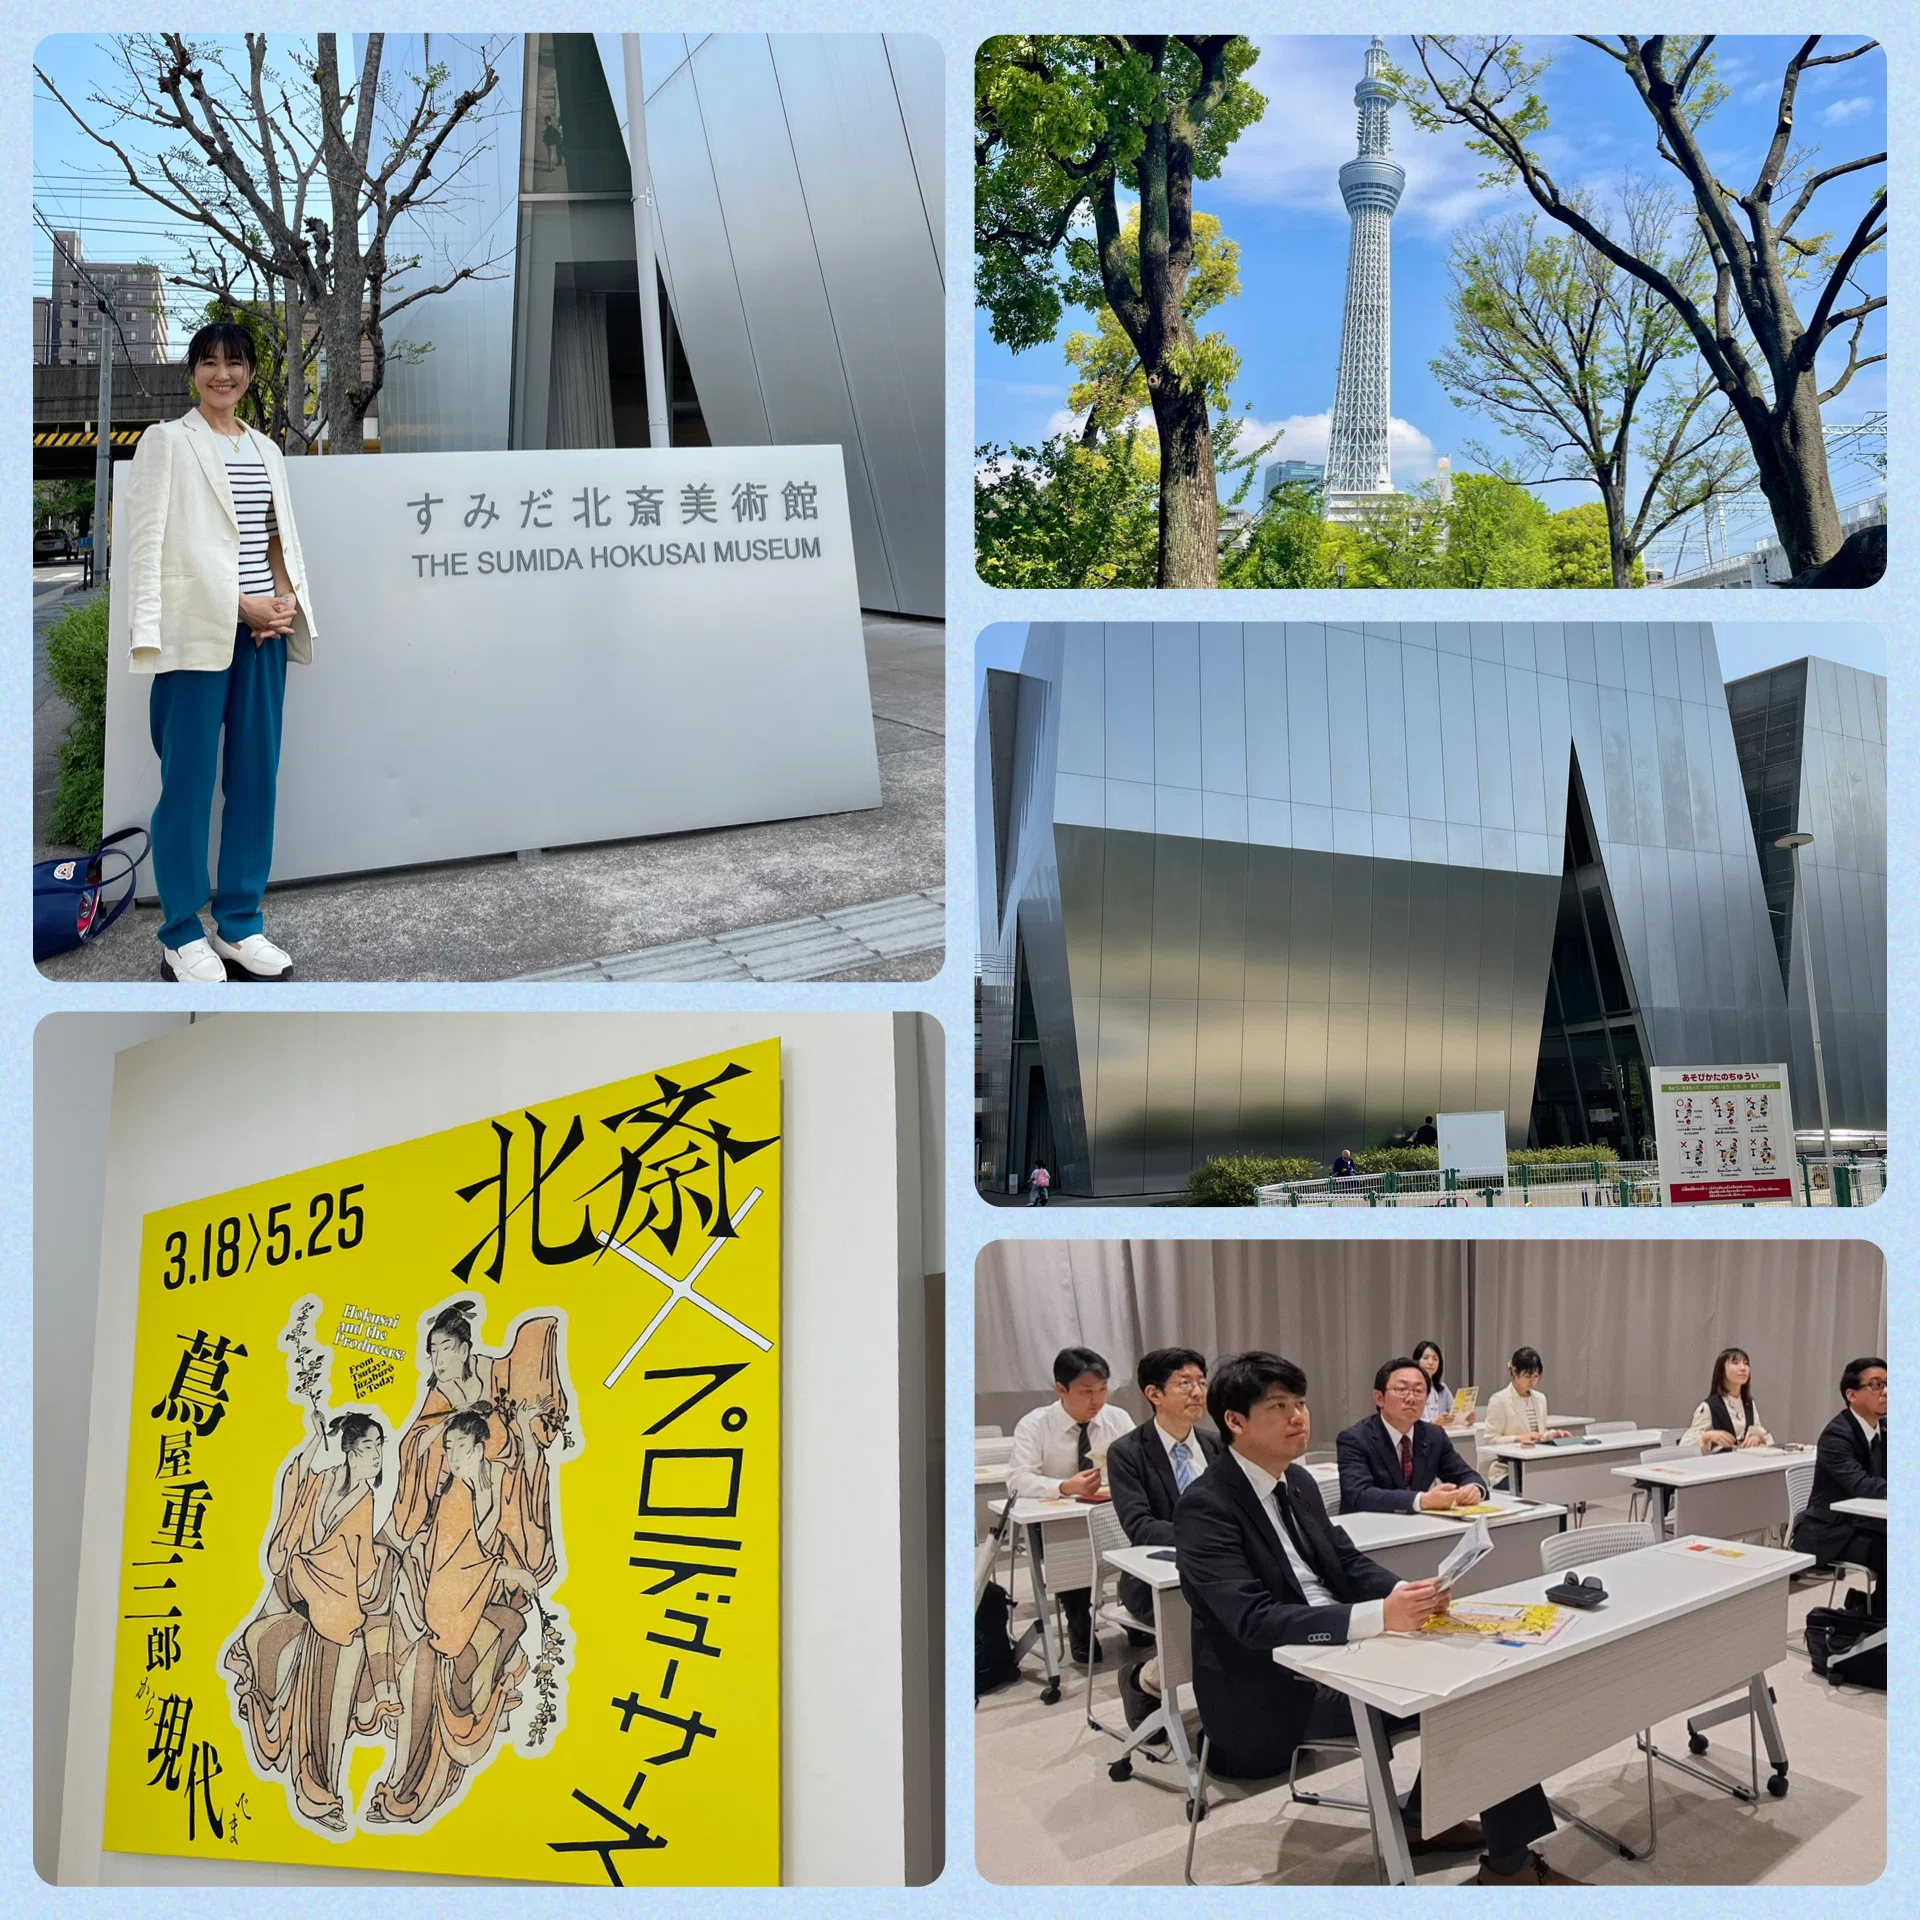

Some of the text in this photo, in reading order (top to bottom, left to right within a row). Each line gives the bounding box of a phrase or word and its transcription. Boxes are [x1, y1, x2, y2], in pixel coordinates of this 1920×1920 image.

[407, 480, 818, 534] すみだ北斎美術館
[412, 537, 822, 577] THE SUMIDA HOKUSAI MUSEUM
[1682, 1072, 1760, 1082] あそびかたのちゅうい
[342, 1304, 400, 1328] Hokusai
[337, 1321, 388, 1341] and the
[333, 1331, 406, 1361] Producers:
[349, 1357, 374, 1375] From
[351, 1360, 387, 1383] Tsutaya
[356, 1374, 395, 1400] to Today
